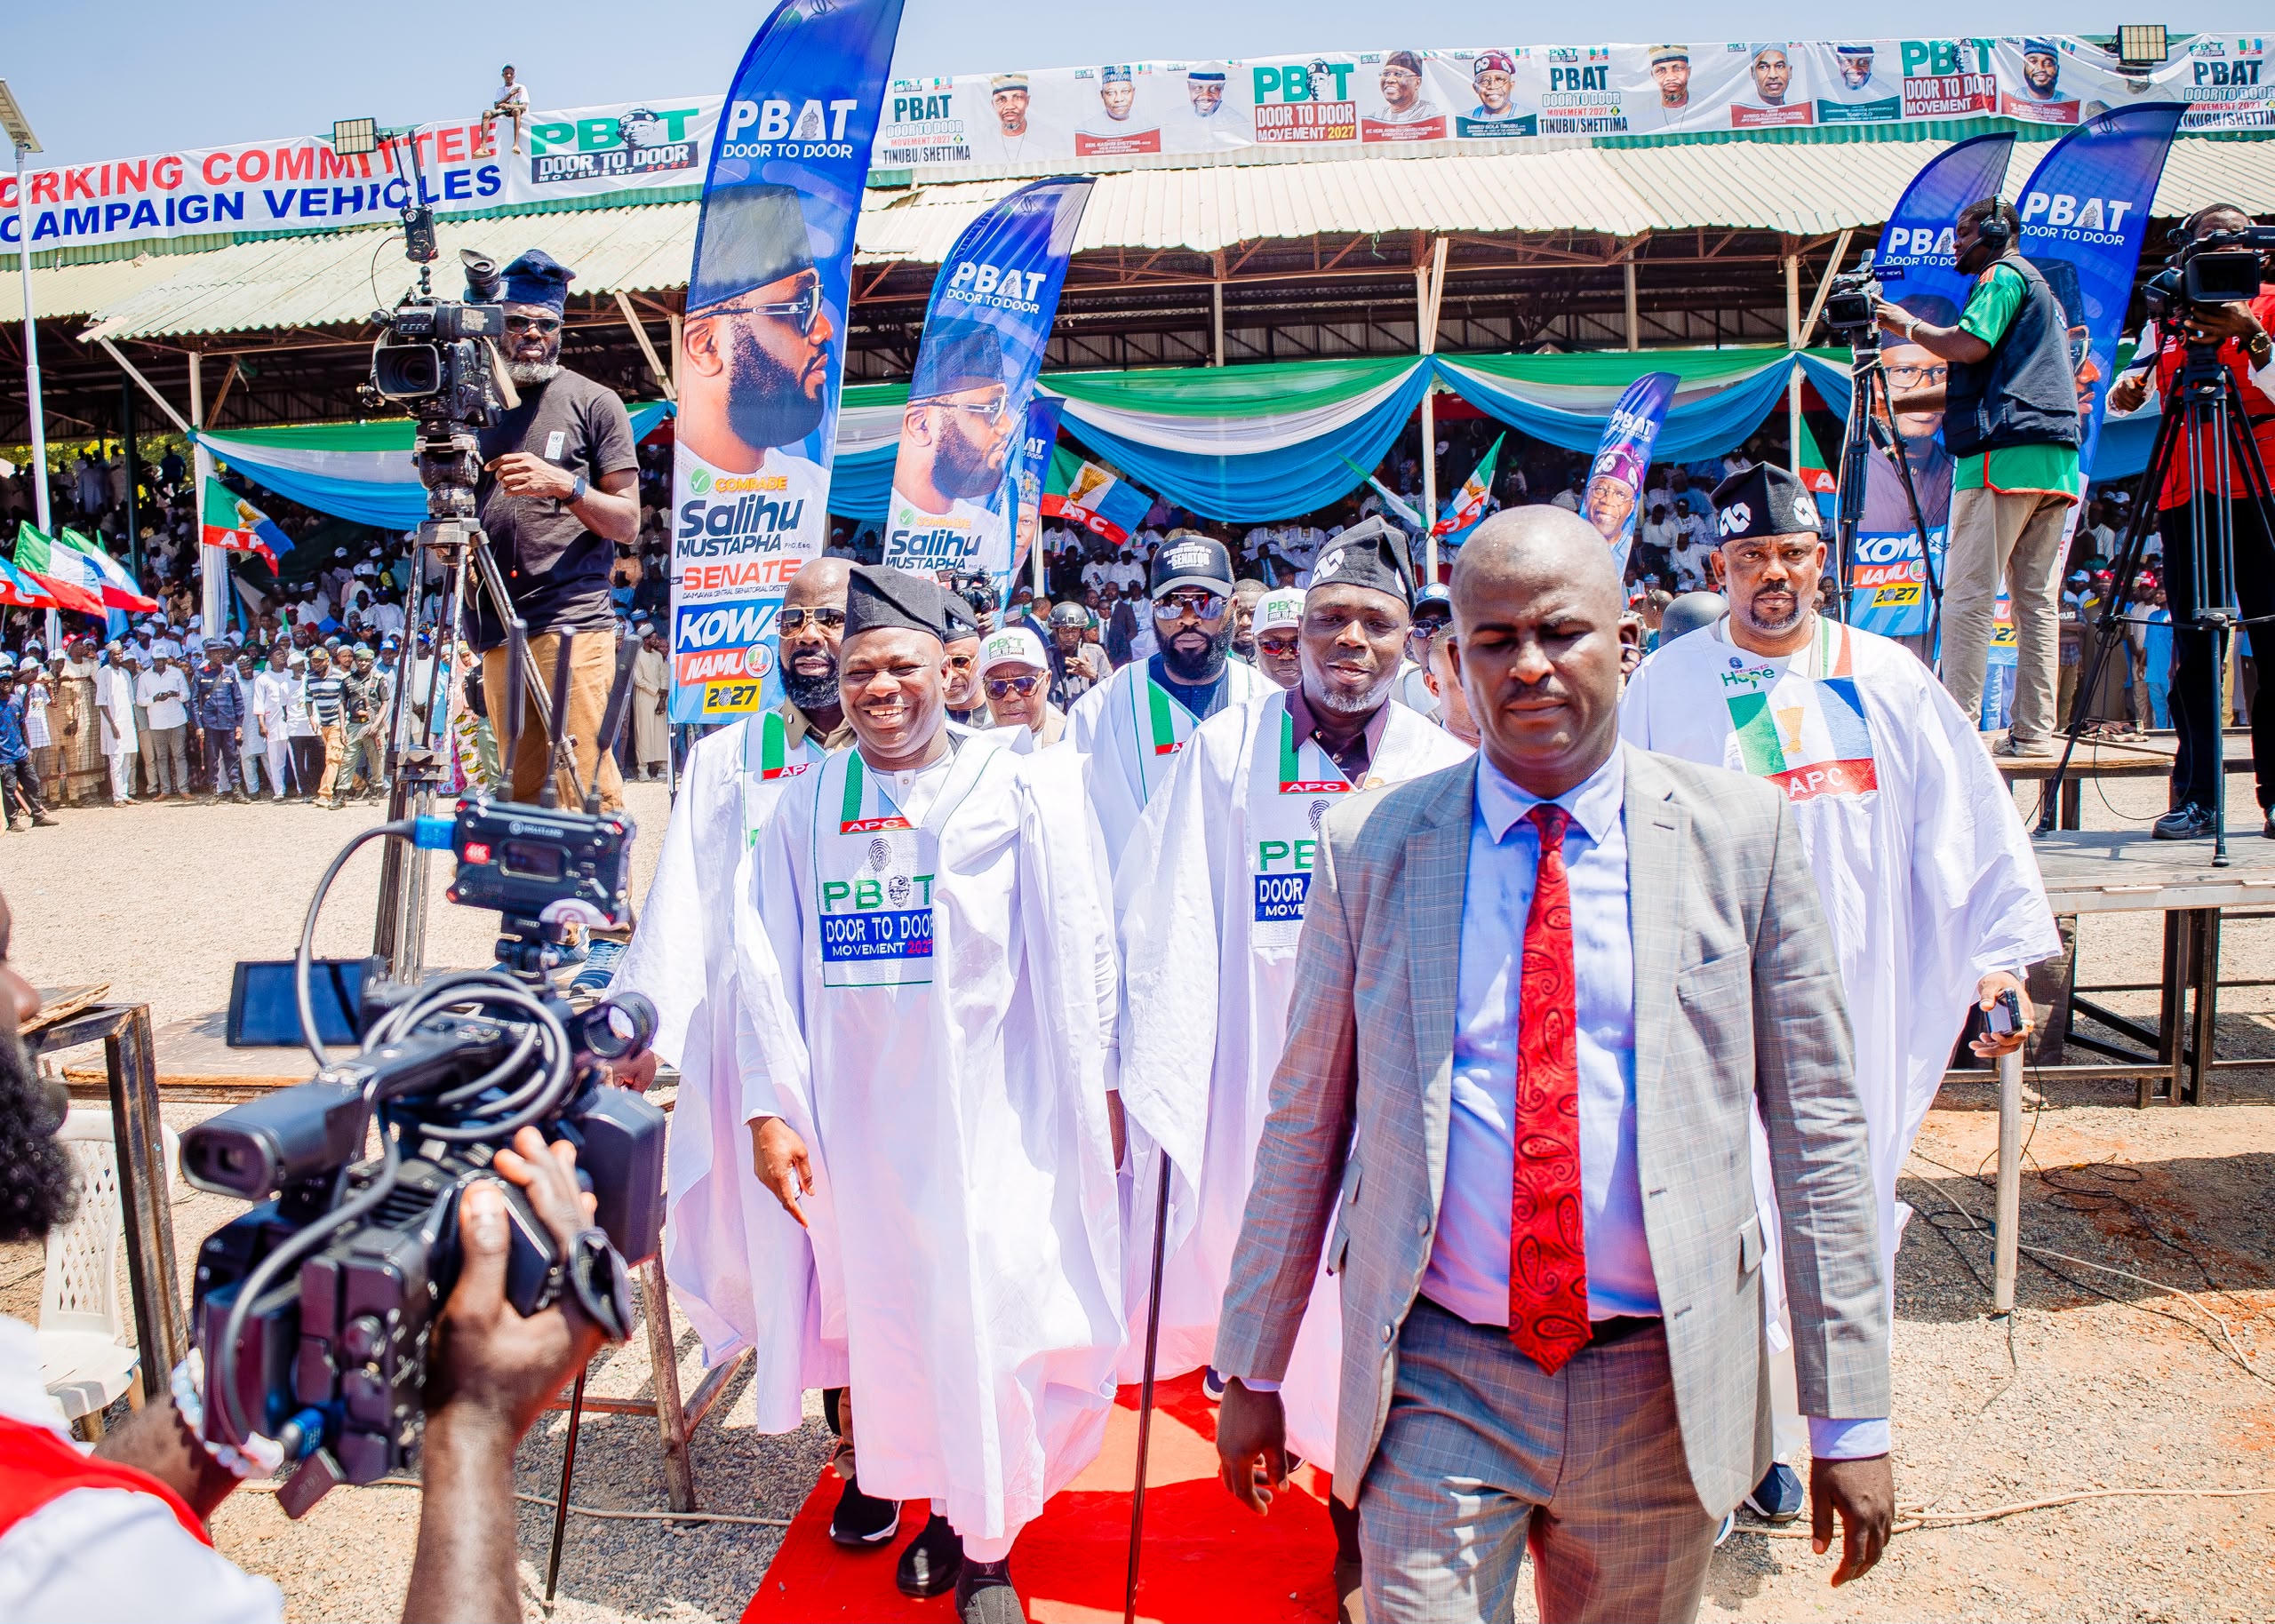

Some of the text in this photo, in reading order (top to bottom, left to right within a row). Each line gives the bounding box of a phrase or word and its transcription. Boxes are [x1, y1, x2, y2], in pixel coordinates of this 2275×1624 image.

[1550, 66, 1608, 91] PBAT
[2193, 60, 2263, 85] PBAT
[1905, 79, 1939, 100] DOOR
[1943, 78, 1960, 98] TO
[2184, 87, 2219, 101] DOOR
[2220, 87, 2238, 101] TO
[894, 94, 952, 123] PBAT
[1543, 92, 1621, 107] DOOR TO DOOR
[1905, 100, 1972, 114] MOVEMENT
[726, 100, 858, 141] PBAT
[1256, 103, 1355, 128] DOOR TO DOOR
[1540, 117, 1628, 133] TINUBU/SHETTIMA
[886, 120, 963, 138] DOOR TO DOOR
[1257, 127, 1326, 141] MOVEMENT
[1328, 125, 1355, 139] 2027
[891, 135, 950, 147] MOVEMENT 2027
[539, 145, 690, 175] DOOR TO DOOR
[722, 144, 853, 159] DOOR TO DOOR
[883, 145, 971, 164] TINUBU/SHETTIMA
[539, 161, 690, 181] MOVEMENT 2027
[0, 164, 501, 243] CAMPAIGN VEHICLES
[2021, 192, 2133, 233] PBAT
[1887, 227, 1956, 256] PBA
[2062, 227, 2079, 241] TO
[2082, 231, 2126, 246] DOOR
[1885, 255, 1957, 267] DOOR TO DO
[950, 261, 1047, 302] PBAT
[946, 288, 1040, 314] DOOR TO DOOR
[1023, 437, 1046, 454] AT
[714, 476, 788, 493] COMRADE
[678, 494, 804, 538] Salihu
[916, 516, 972, 529] COMRADE
[220, 530, 266, 549] AP
[676, 534, 781, 559] MUSTAPHA
[889, 529, 982, 557] Salihu
[885, 556, 966, 569] MUSTAPHA
[1171, 552, 1210, 568] SENATOR
[683, 559, 802, 591] SENATE
[2059, 610, 2076, 620] OLICE
[685, 653, 745, 681] NAMU
[1720, 668, 1776, 690] Hope
[1286, 783, 1341, 792] APC
[1789, 767, 1845, 798] APC
[847, 819, 900, 832] APC
[1259, 878, 1304, 904] DOOR
[1265, 904, 1305, 918] MOVE
[826, 919, 866, 943] DOOR
[872, 916, 893, 940] TO
[833, 942, 906, 957] MOVEMENT
